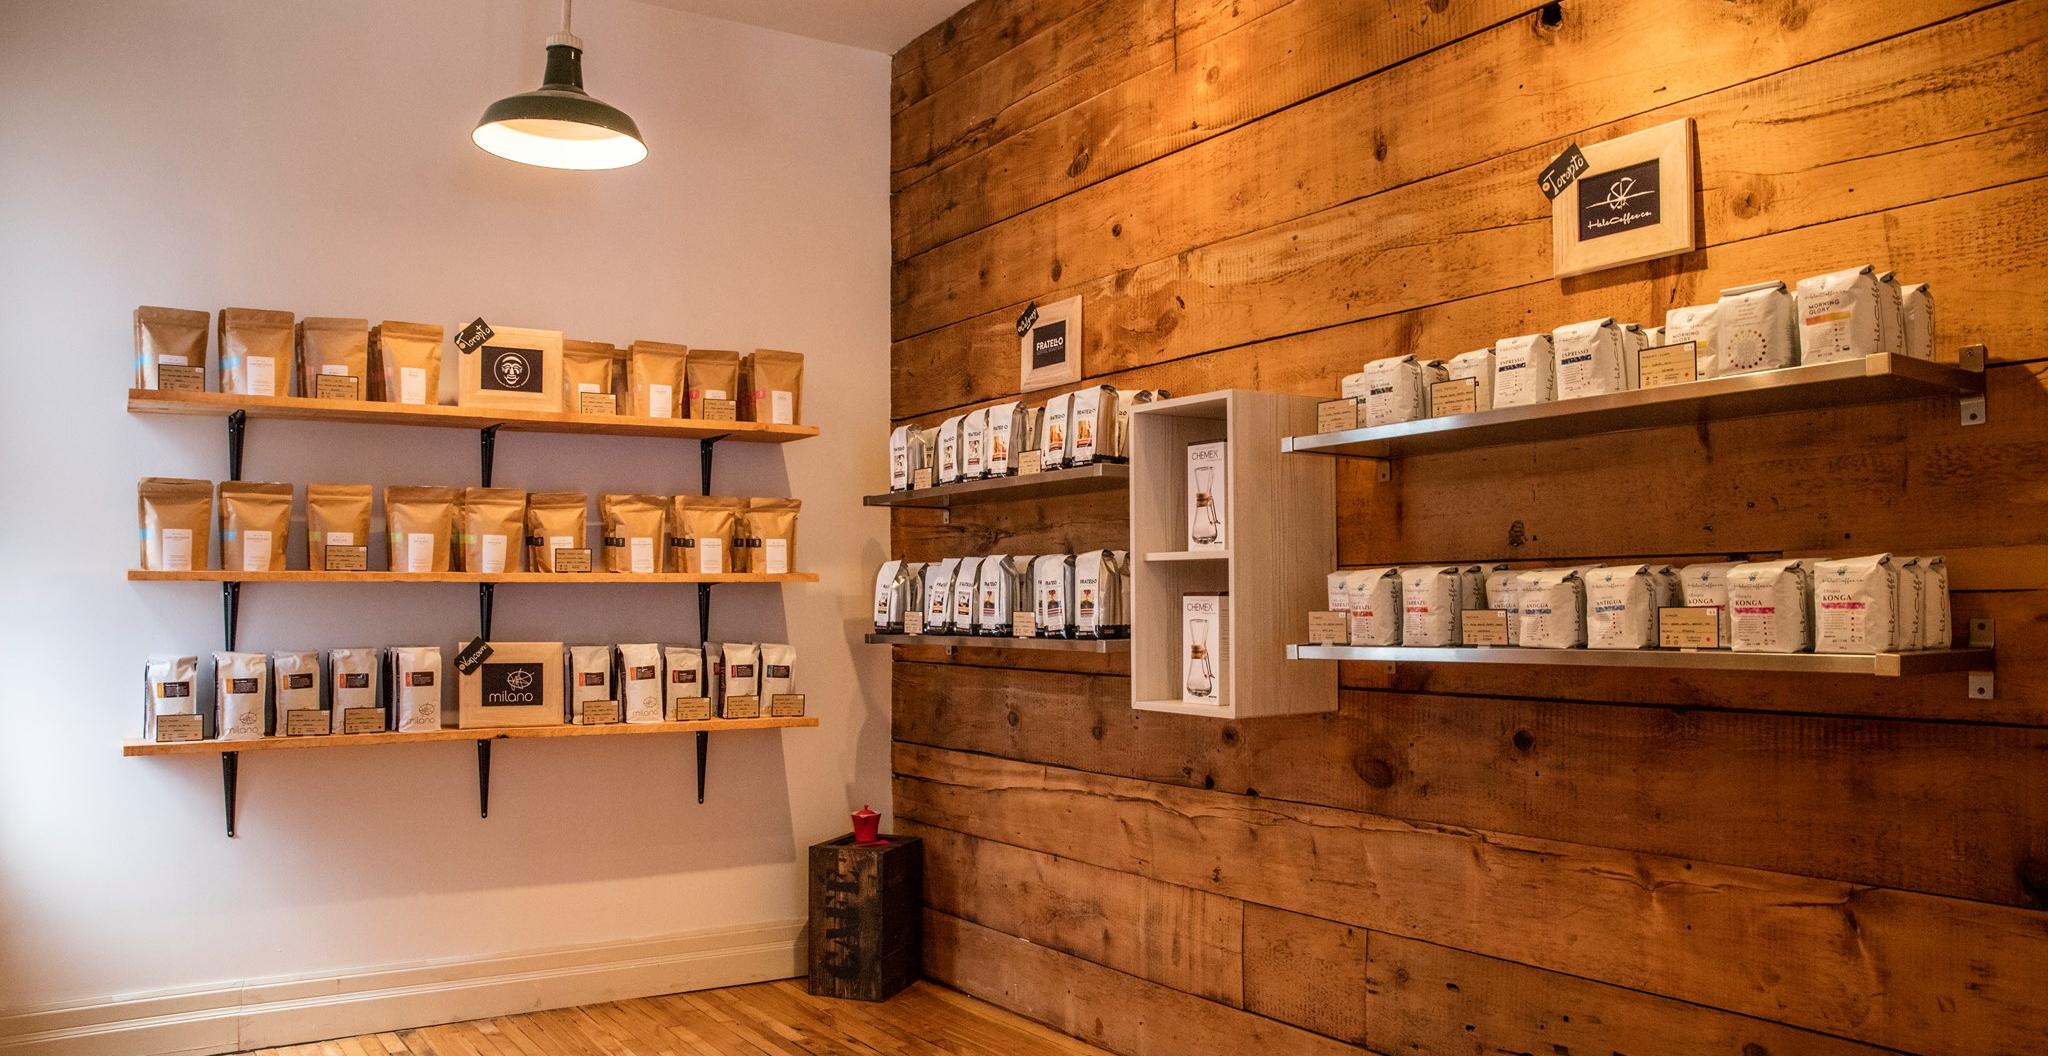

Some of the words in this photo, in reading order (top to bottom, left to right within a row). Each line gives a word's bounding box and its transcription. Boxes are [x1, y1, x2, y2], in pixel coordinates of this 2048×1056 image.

[1543, 154, 1584, 195] Toronto
[1808, 298, 1840, 310] MORNING
[1808, 306, 1830, 316] GLORY
[1192, 450, 1219, 460] CHEMEX
[1187, 602, 1213, 612] CHEMEX
[489, 690, 533, 702] milano
